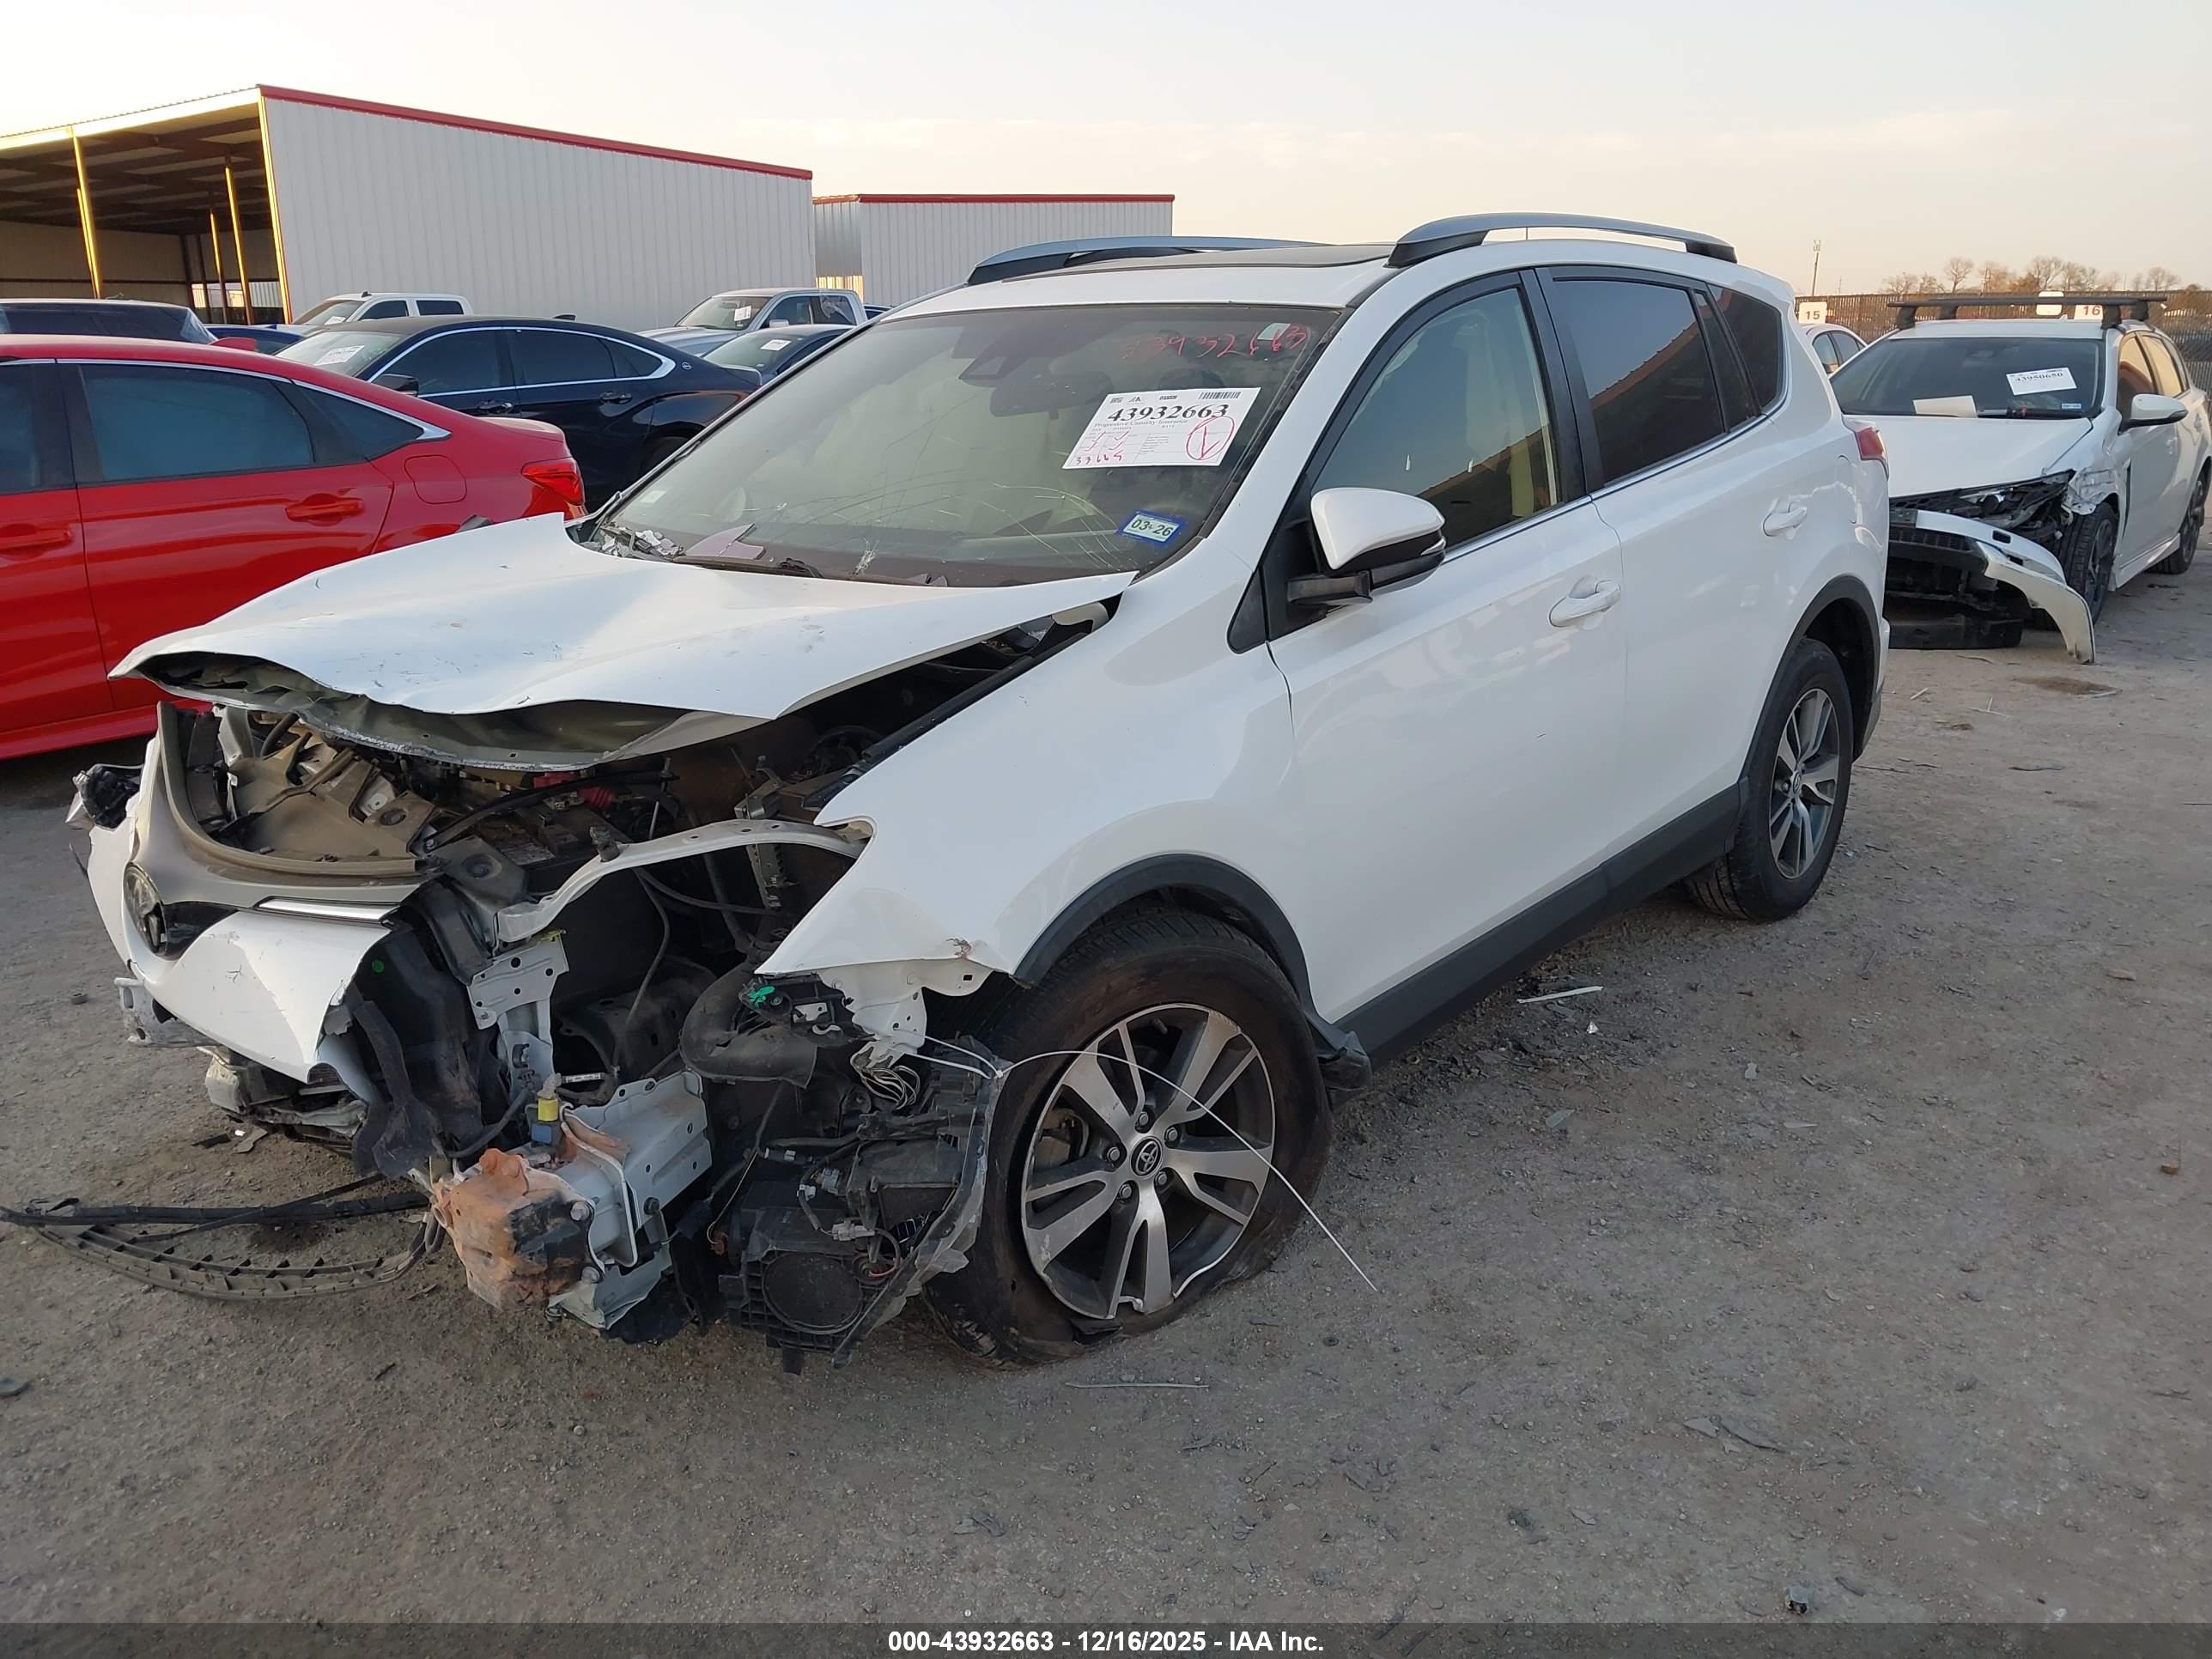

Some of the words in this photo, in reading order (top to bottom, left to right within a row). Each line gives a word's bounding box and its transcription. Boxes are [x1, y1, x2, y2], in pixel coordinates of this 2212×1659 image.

[1805, 310, 1820, 320] 15
[2082, 306, 2101, 316] 16
[1107, 404, 1229, 422] 43932663
